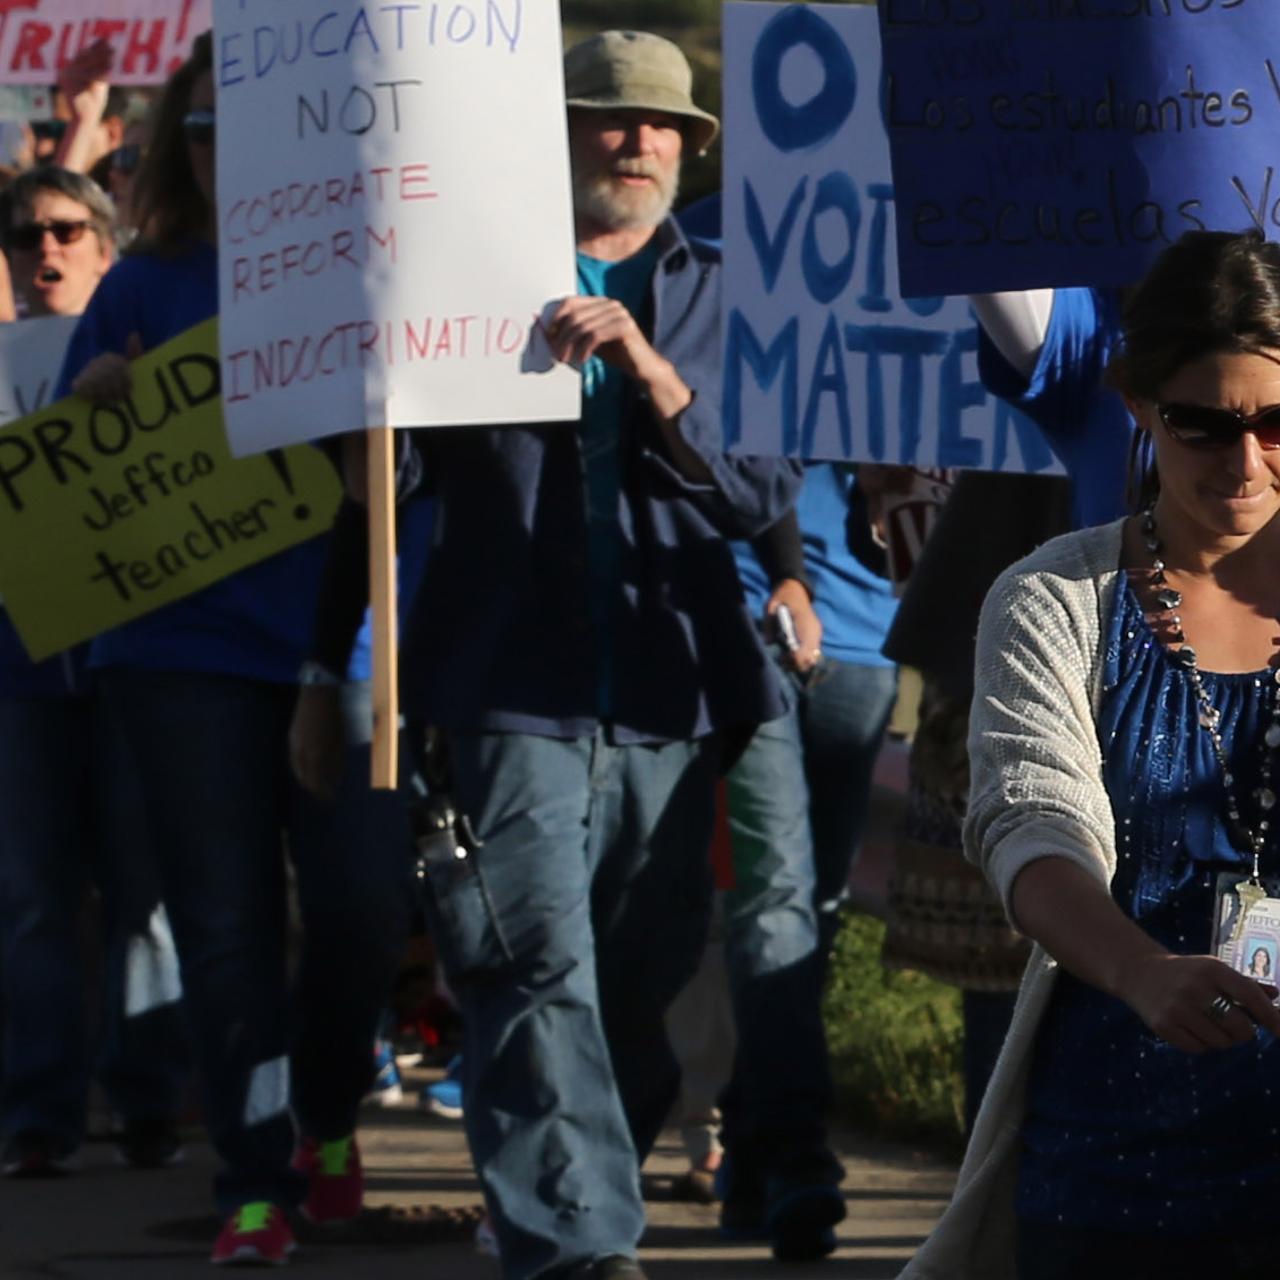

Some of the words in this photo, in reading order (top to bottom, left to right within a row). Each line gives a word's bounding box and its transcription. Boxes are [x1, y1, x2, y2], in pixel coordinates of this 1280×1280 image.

[297, 80, 422, 141] NOT
[227, 163, 438, 245] CORPORATE
[231, 226, 397, 302] REFORM
[0, 352, 220, 513] PROUD
[82, 449, 216, 533] Jeffco
